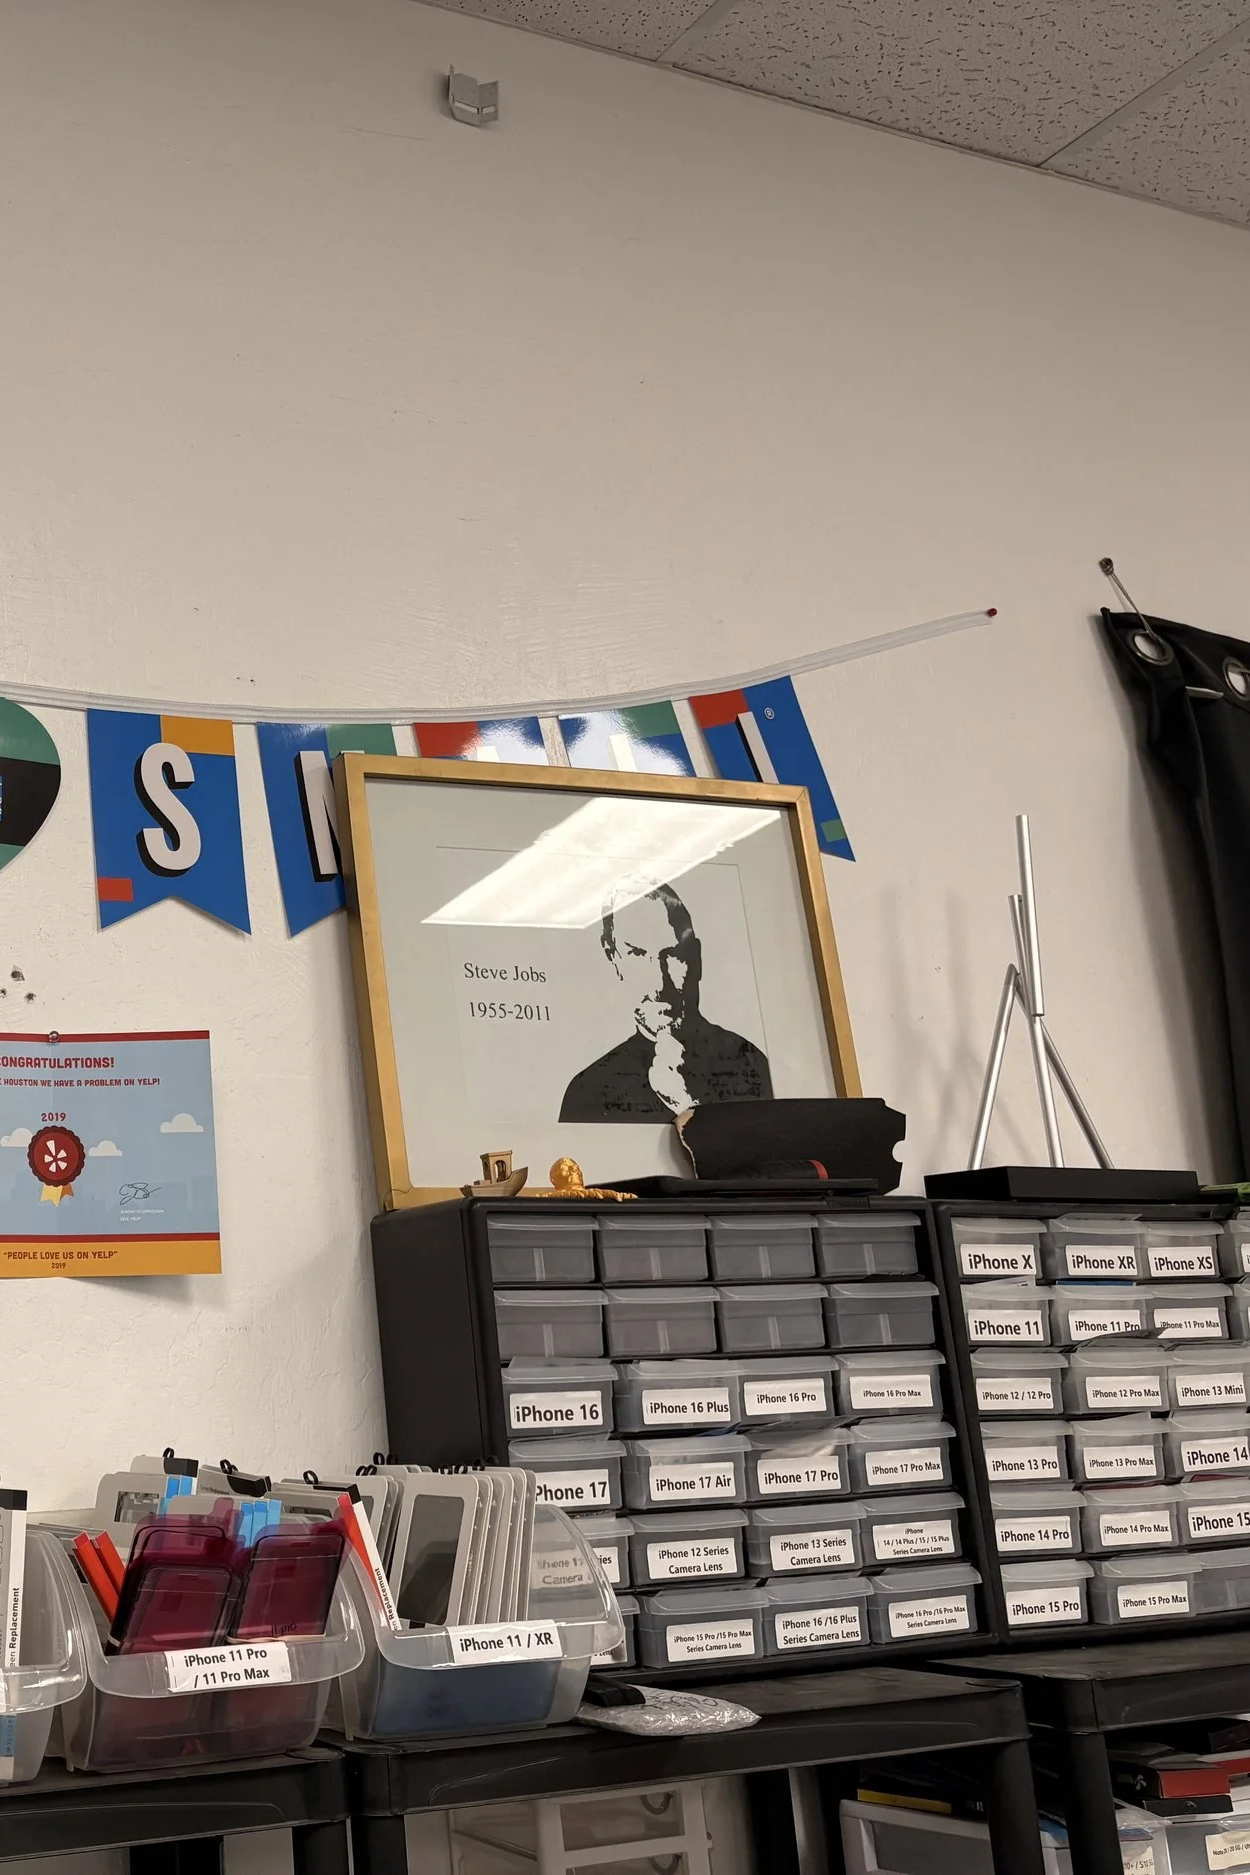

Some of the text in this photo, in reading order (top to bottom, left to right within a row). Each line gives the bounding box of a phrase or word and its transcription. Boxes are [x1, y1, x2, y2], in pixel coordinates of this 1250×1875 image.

[464, 962, 546, 983] Steve Jobs
[470, 1002, 550, 1021] 1955-2011
[4, 1078, 38, 1086] HOUSTON
[40, 1079, 52, 1087] WE
[77, 1079, 82, 1087] A
[84, 1079, 121, 1087] PROBLEM
[124, 1078, 134, 1086] ON
[41, 1112, 66, 1122] 2019
[969, 1254, 1033, 1270] iPhone X
[1072, 1255, 1135, 1270] iPhone XR
[1154, 1256, 1213, 1271] iPhone XS
[974, 1320, 1040, 1336] iPhone 11
[757, 1392, 817, 1404] iPhone 16 Pro
[863, 1389, 885, 1398] iPhone
[896, 1389, 906, 1397] Pro
[908, 1389, 922, 1397] Max
[1092, 1389, 1159, 1399] iPhone 12 Pro Max
[1181, 1384, 1243, 1398] iPhone 13 Mini
[515, 1404, 599, 1423] iPhone 16
[650, 1401, 729, 1414] iPhone 16 Plus
[1187, 1446, 1249, 1467] iPhone 14
[872, 1461, 940, 1475] iPhone 17 Pro Max
[992, 1459, 1058, 1472] iPhone 13 Pro
[656, 1475, 731, 1492] iPhone 17 Air
[764, 1469, 838, 1485] iPhone 17 Pro
[535, 1481, 607, 1502] Phone 17
[1192, 1512, 1250, 1532] iPhone 15
[1001, 1530, 1069, 1543] iPhone 14 Pro
[781, 1538, 847, 1552] iPhone 13 Series
[659, 1547, 729, 1560] iPhone 12 Series
[790, 1554, 841, 1566] Camera Lens
[668, 1563, 723, 1575] Camera Lens
[374, 1567, 395, 1625] Replacement
[1122, 1595, 1187, 1608] iPhone 15 Pro Max
[1012, 1601, 1079, 1616] iPhone 15 Pro
[9, 1588, 19, 1648] Replacement
[783, 1615, 857, 1630] iPhone 16 /16 Plus
[459, 1632, 553, 1652] iPhone 11 / XR
[783, 1630, 860, 1645] Series Camera Lens
[185, 1649, 267, 1667] iPhone 11 Pro
[203, 1674, 217, 1686] 11
[221, 1670, 241, 1683] Pro
[244, 1668, 270, 1679] Max
